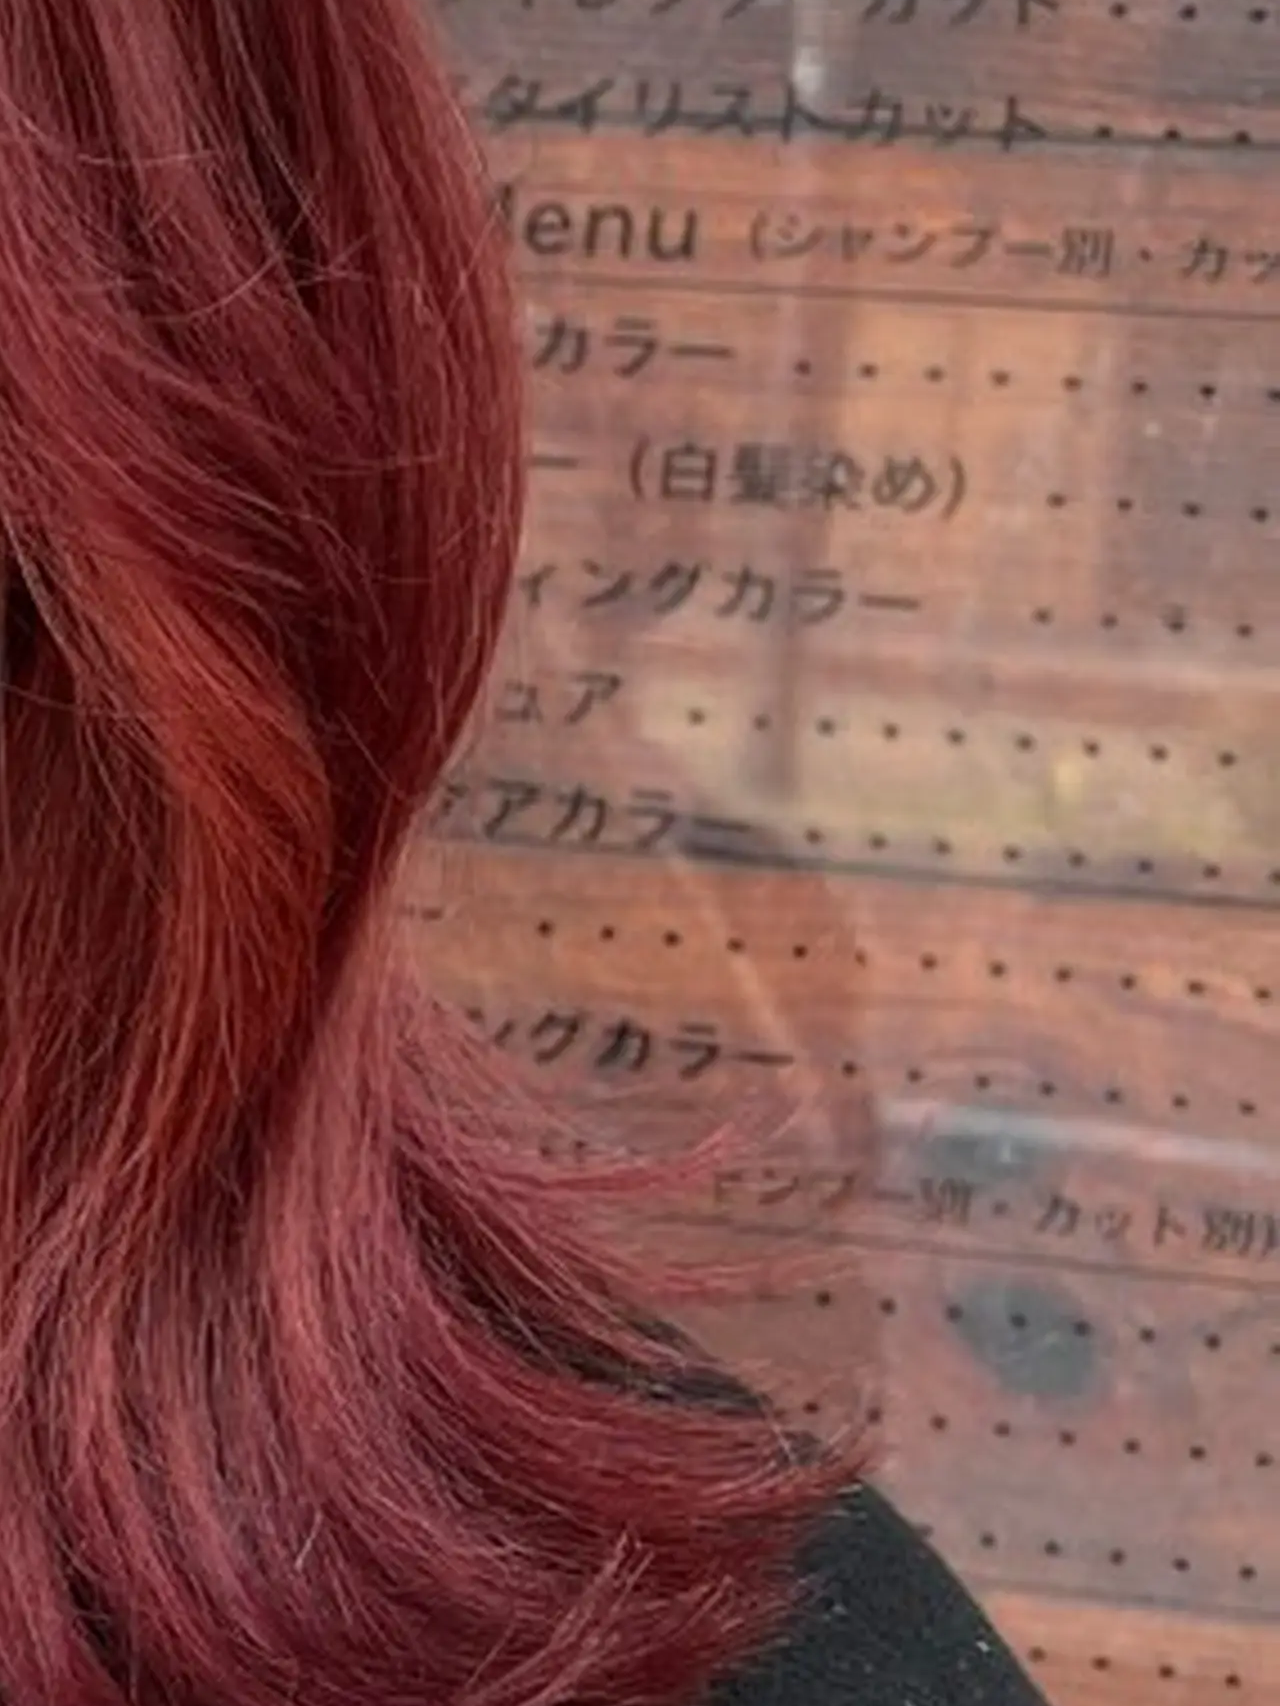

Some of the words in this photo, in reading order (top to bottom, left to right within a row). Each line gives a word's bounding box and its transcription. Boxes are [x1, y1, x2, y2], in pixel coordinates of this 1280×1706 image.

[454, 73, 1048, 149] タイリストカット
[533, 317, 737, 378] カラー
